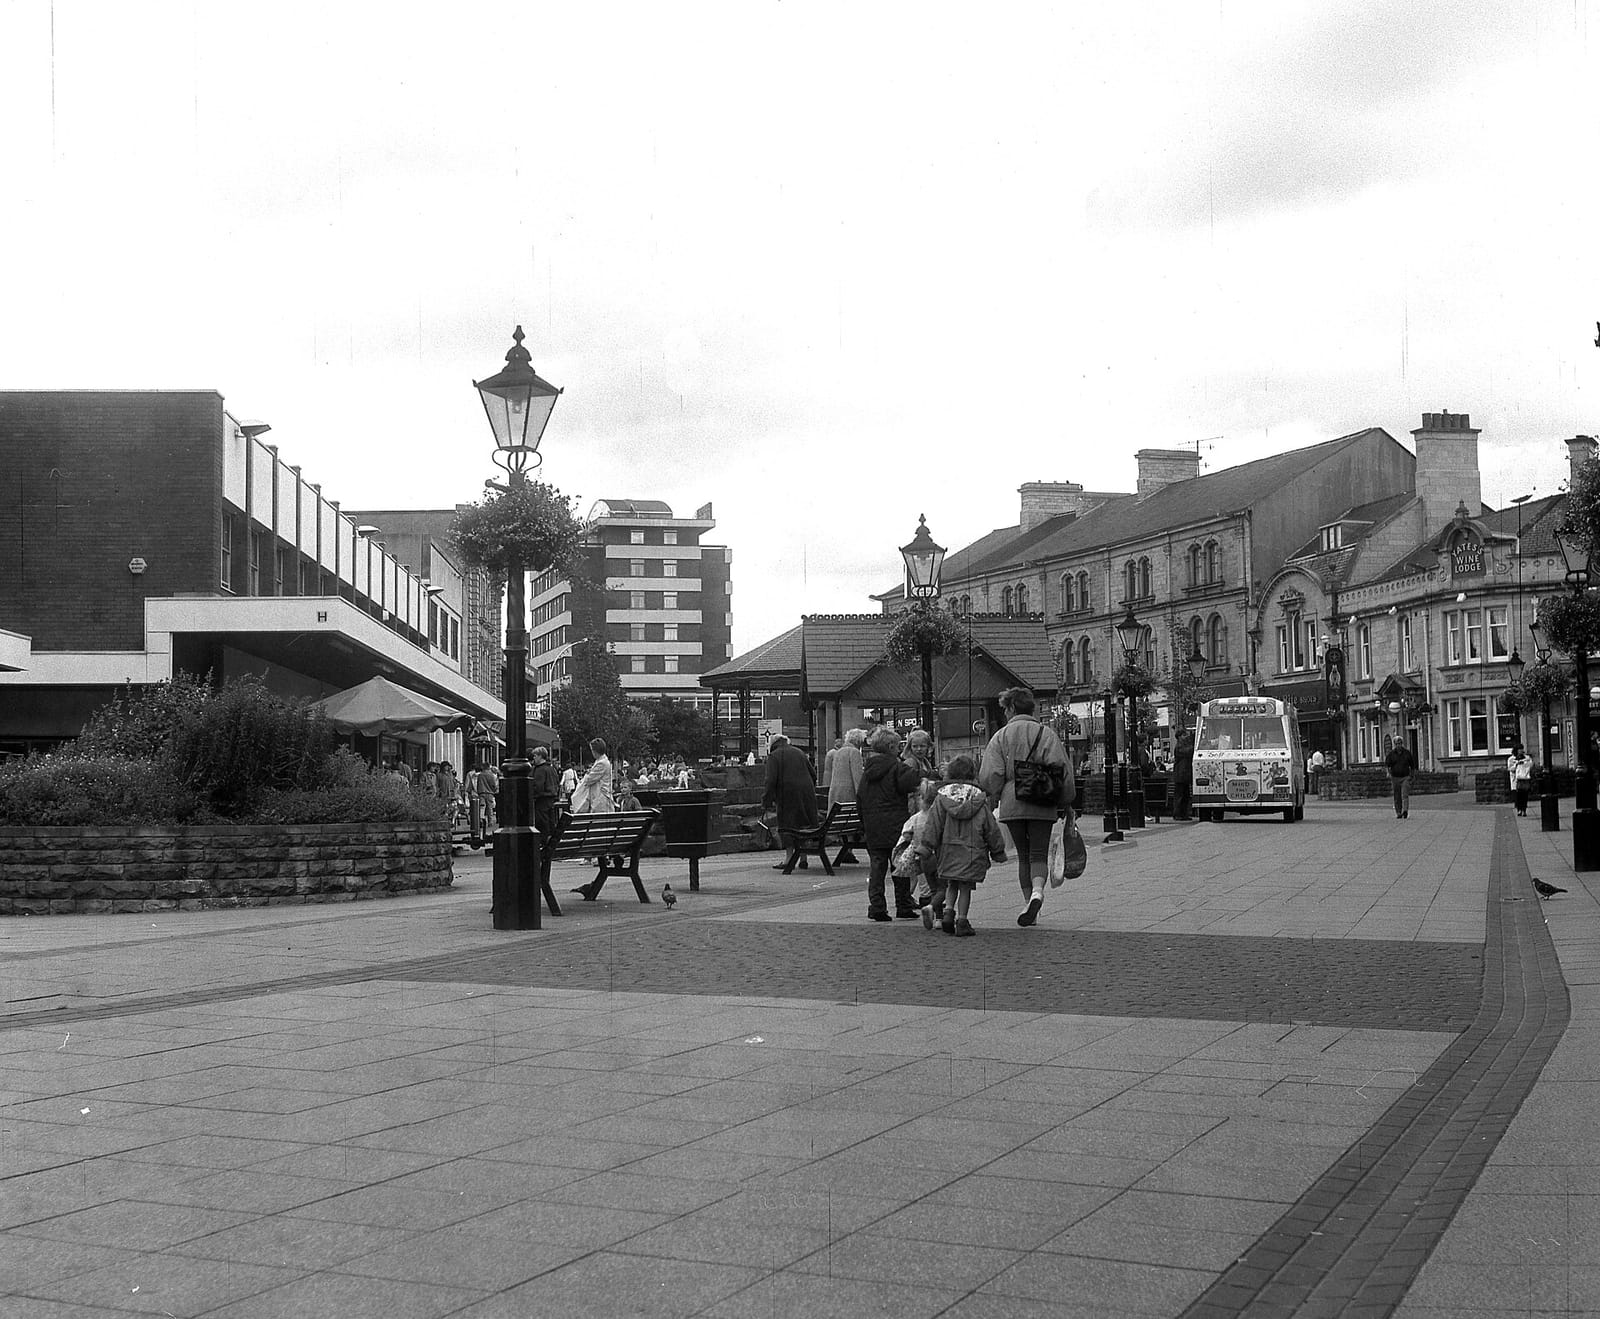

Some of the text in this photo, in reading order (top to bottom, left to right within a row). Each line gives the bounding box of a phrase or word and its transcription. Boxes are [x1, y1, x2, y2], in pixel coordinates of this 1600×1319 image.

[1456, 554, 1480, 565] WINE
[1454, 562, 1482, 574] LODGE
[317, 611, 328, 623] H
